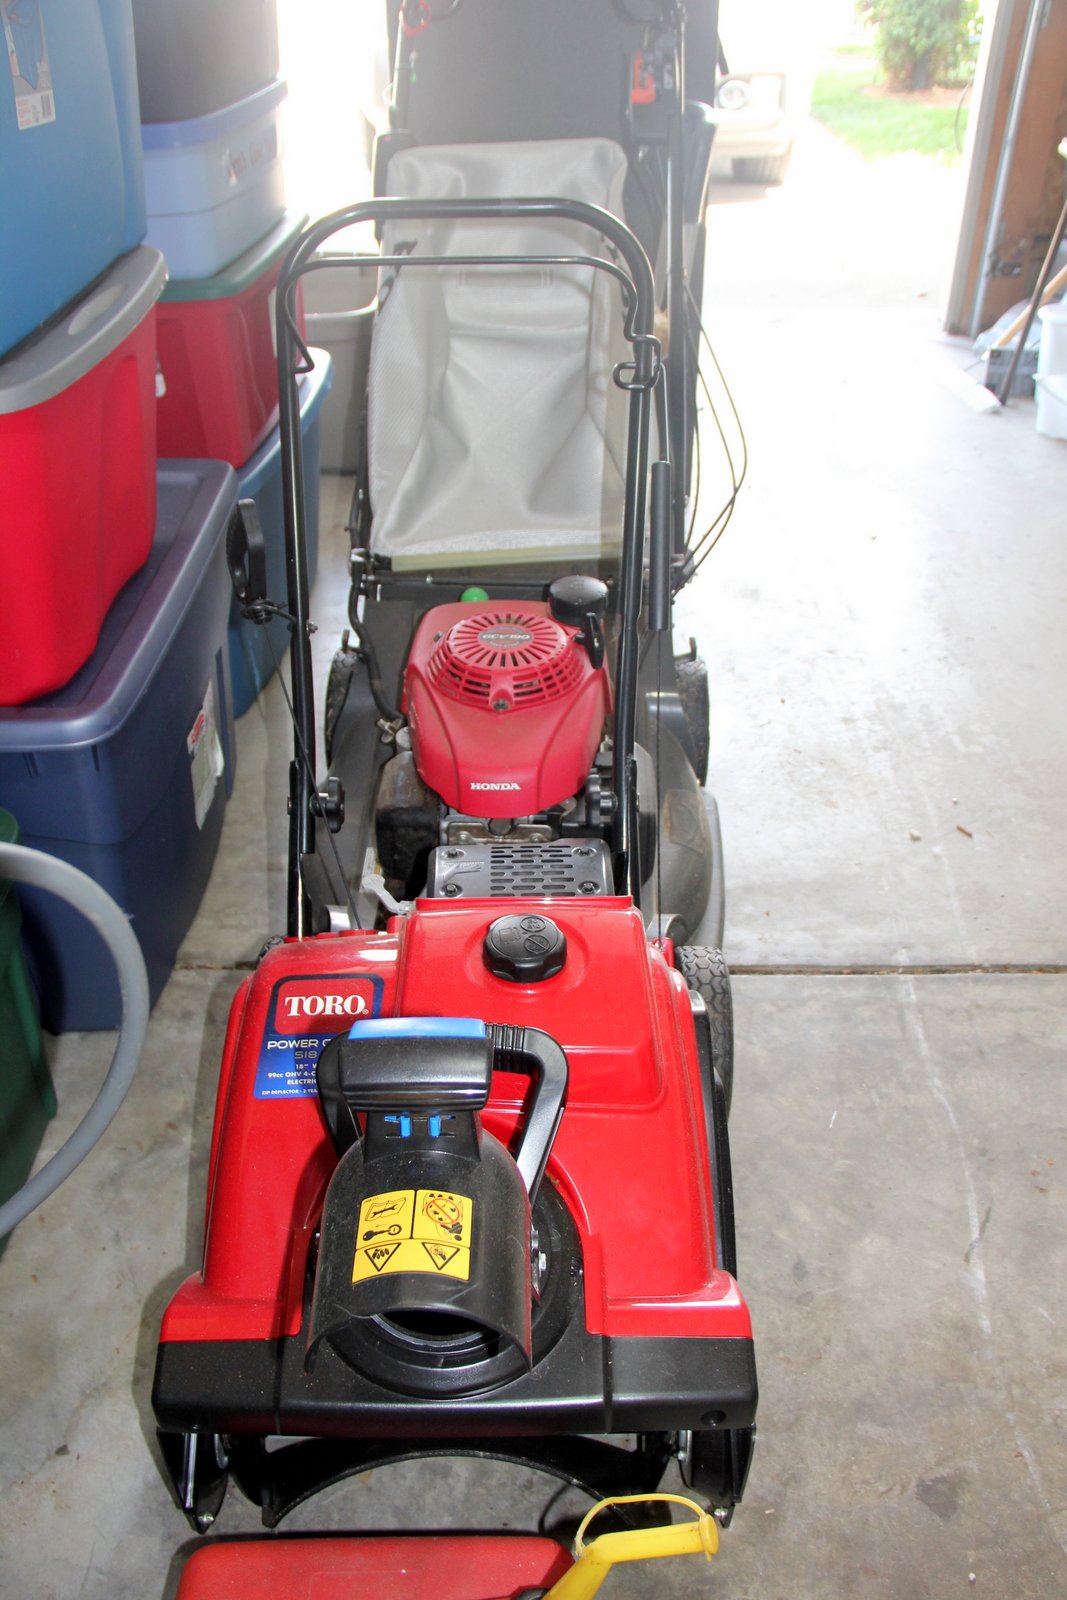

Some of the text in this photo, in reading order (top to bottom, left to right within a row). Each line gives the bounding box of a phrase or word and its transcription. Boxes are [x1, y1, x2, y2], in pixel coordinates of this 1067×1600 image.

[470, 782, 521, 790] HONDA
[267, 1039, 319, 1050] POWER
[285, 1070, 302, 1078] OHV
